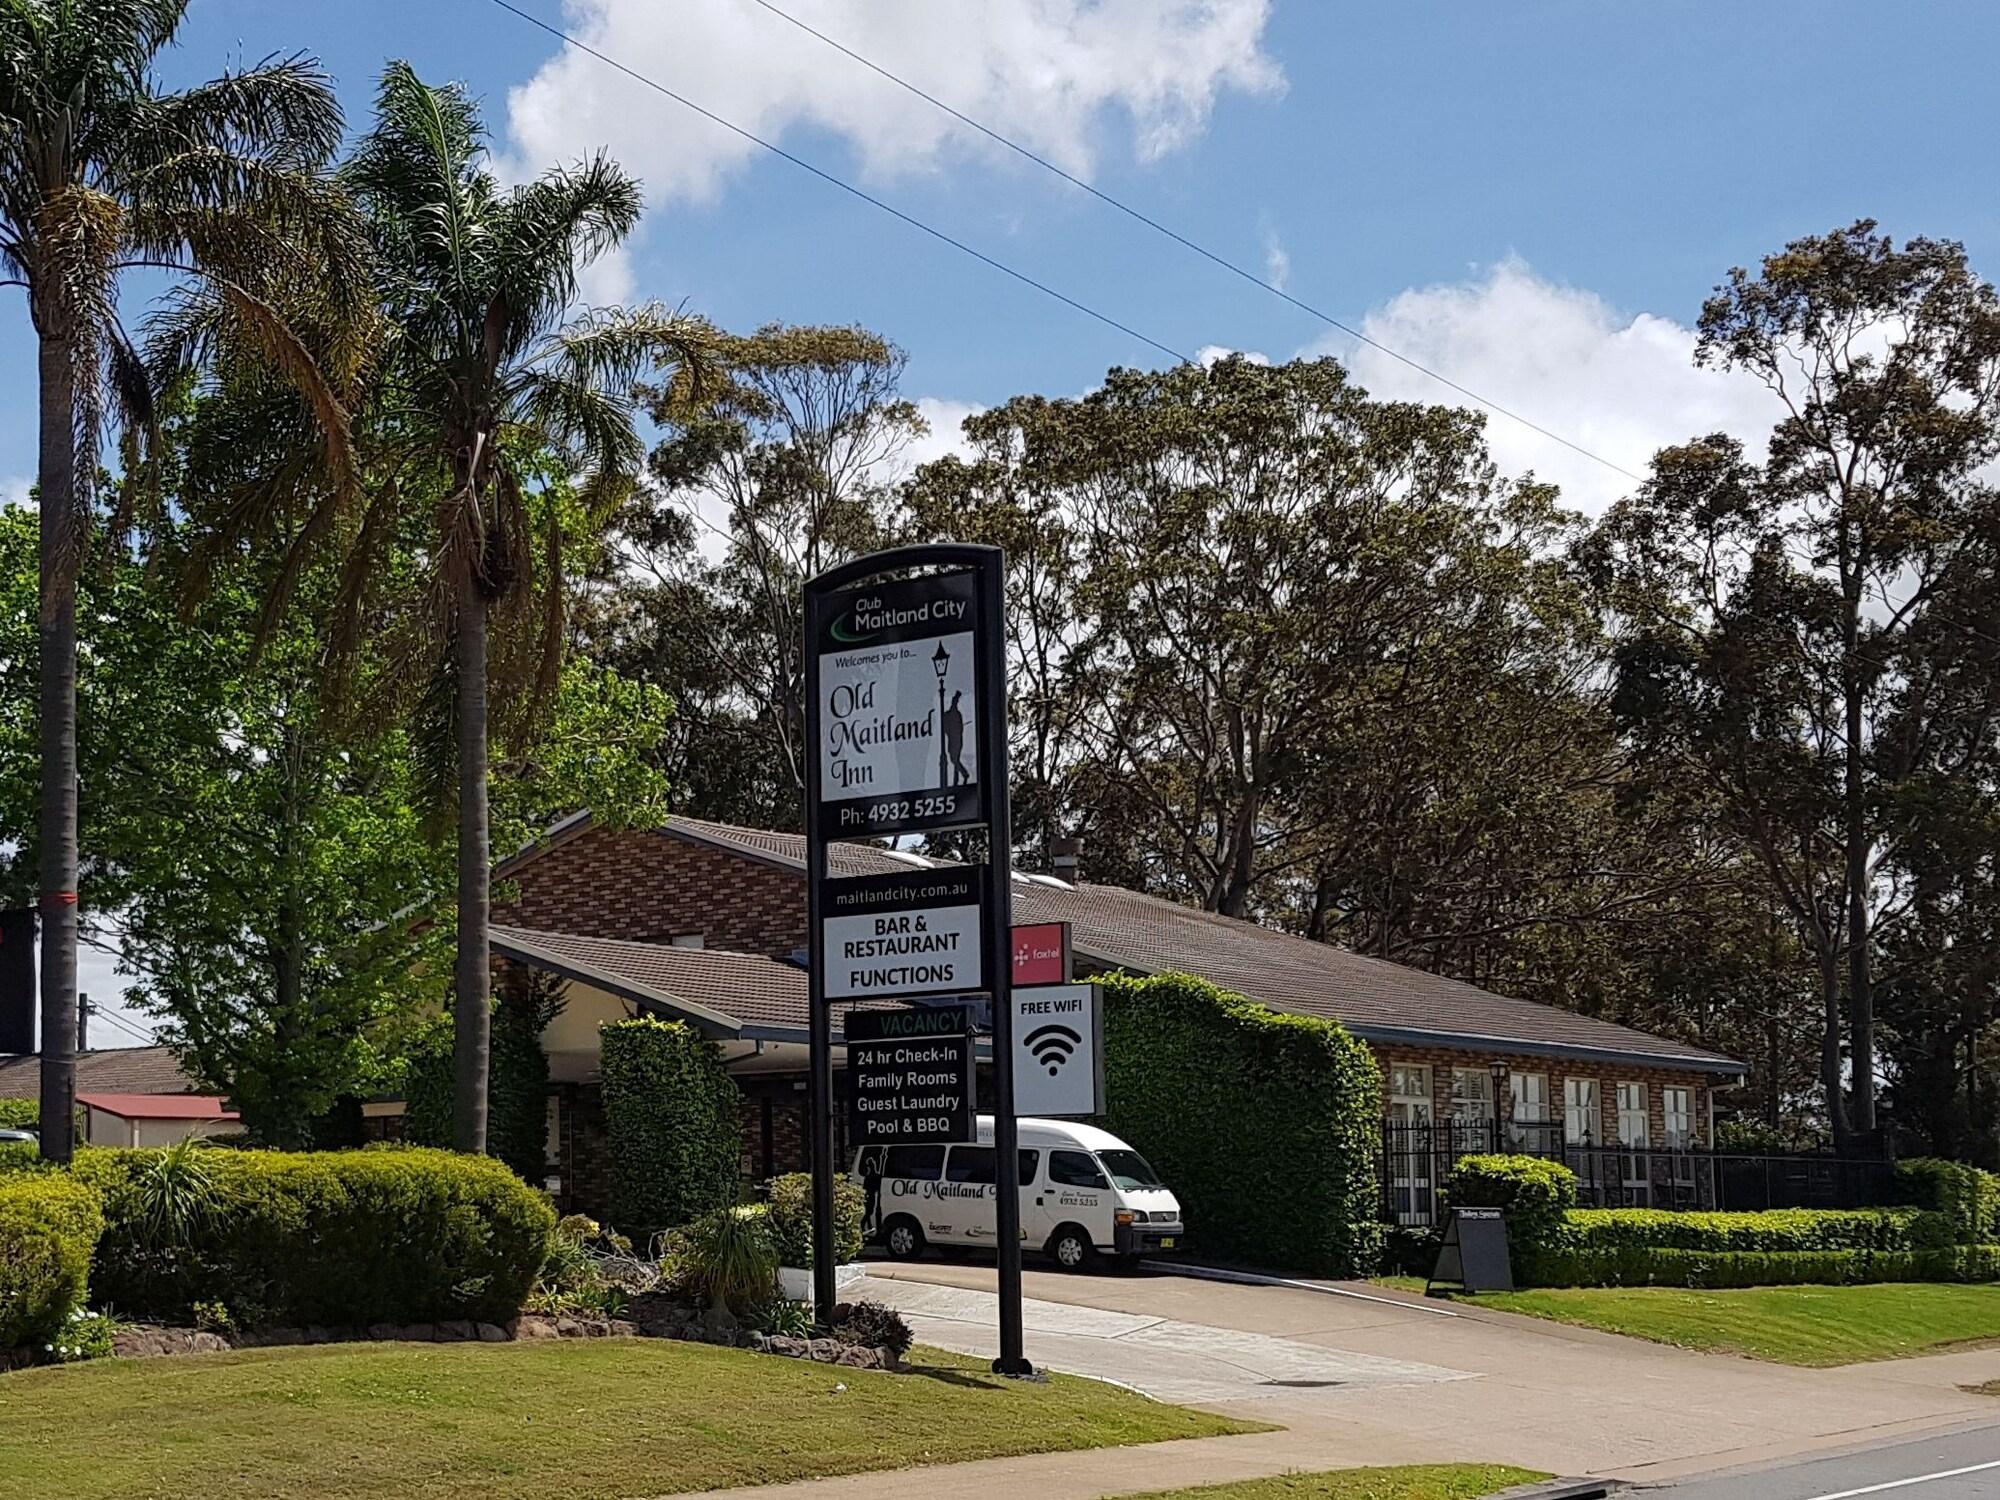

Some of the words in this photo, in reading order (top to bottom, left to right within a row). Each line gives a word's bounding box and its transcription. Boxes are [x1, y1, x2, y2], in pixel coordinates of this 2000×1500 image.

[855, 596, 881, 612] Club
[855, 602, 929, 632] Maitland
[932, 598, 966, 619] City
[835, 653, 880, 669] Welcomes
[881, 650, 898, 665] you
[830, 681, 876, 718] Old
[830, 709, 935, 757] Maitland
[831, 760, 873, 788] Inn
[841, 809, 865, 826] Ph:
[868, 801, 910, 823] 4932
[914, 796, 956, 817] 5255
[837, 881, 968, 905] maitlandcity.com.au
[874, 917, 912, 936] BAR
[914, 915, 927, 932] &
[844, 932, 960, 959] RESTAURANT
[1033, 947, 1060, 959] foxtel
[850, 964, 954, 988] FUNCTIONS
[1021, 1002, 1051, 1015] FREE
[1053, 1000, 1082, 1013] WIFI
[880, 1012, 963, 1035] VACANCY
[857, 1051, 874, 1065] 24
[877, 1050, 892, 1064] hr
[895, 1047, 958, 1064] Check-In
[858, 1074, 903, 1090] Family
[907, 1071, 957, 1086] Rooms
[857, 1096, 898, 1111] Guest
[901, 1094, 960, 1111] Laundry
[867, 1118, 898, 1134] Pool
[903, 1118, 913, 1132] &
[917, 1117, 950, 1132] BBQ
[891, 1179, 920, 1197] Old
[923, 1181, 985, 1201] Maitland
